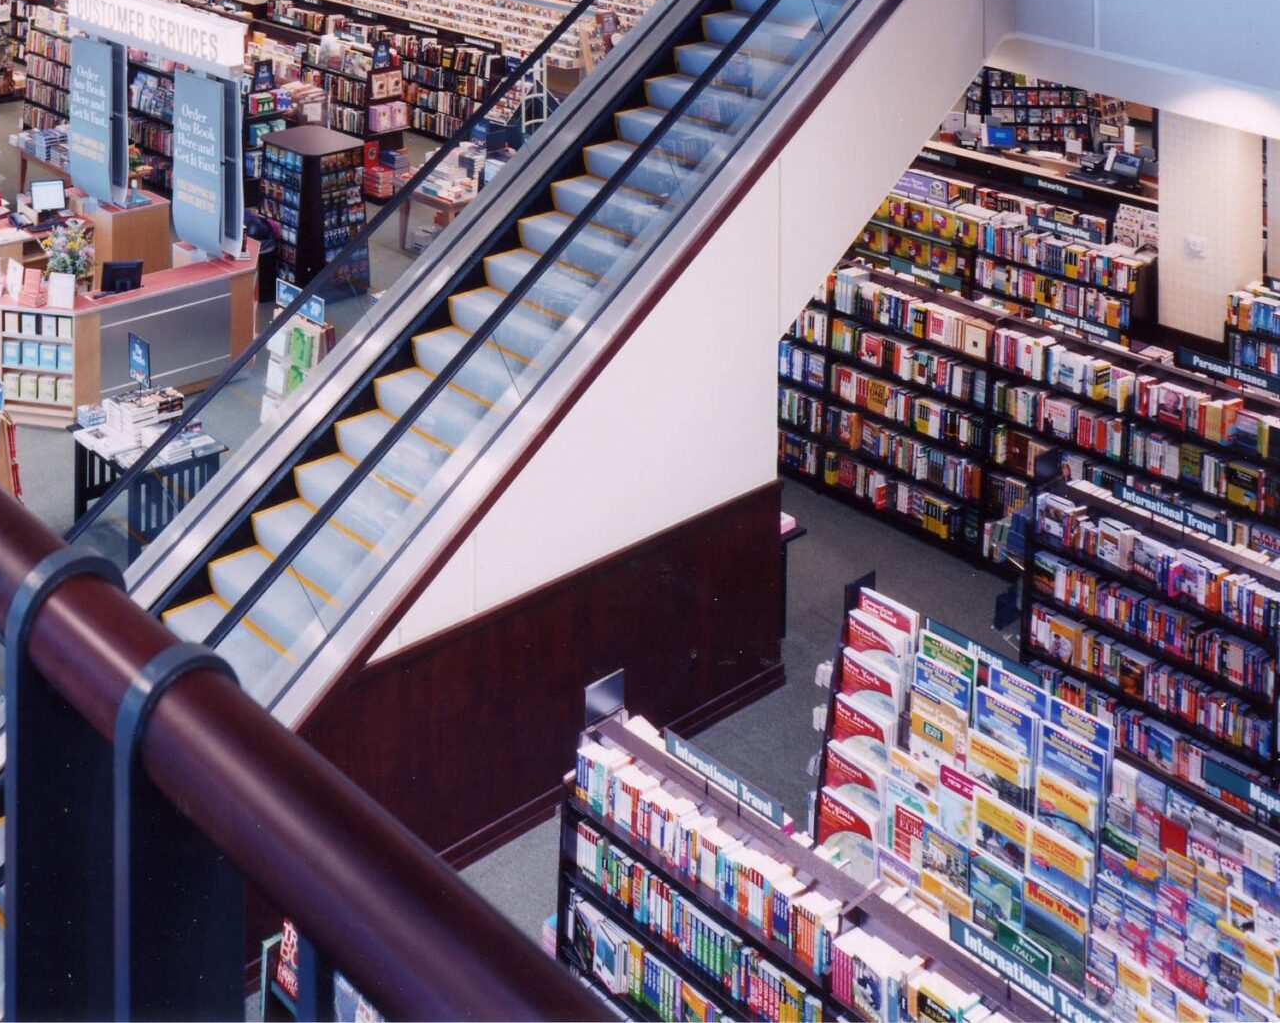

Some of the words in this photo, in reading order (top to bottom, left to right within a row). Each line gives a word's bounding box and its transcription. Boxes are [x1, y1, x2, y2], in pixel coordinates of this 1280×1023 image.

[150, 14, 218, 61] SERVICES
[77, 65, 99, 82] Order
[73, 90, 89, 106] Here
[90, 97, 105, 110] and
[87, 82, 105, 98] Book
[71, 105, 83, 120] Get
[90, 111, 108, 128] Fast.
[181, 104, 208, 123] Order
[178, 118, 192, 135] Any
[193, 124, 216, 142] Book
[178, 133, 197, 149] Here
[198, 142, 215, 157] and
[175, 148, 191, 164] Get
[198, 158, 218, 175] Fast.
[1045, 308, 1077, 327] Personal
[1080, 317, 1108, 337] Finance
[1193, 355, 1231, 376] Personal
[1234, 368, 1267, 388] Finance
[1123, 487, 1183, 523] International
[1187, 512, 1216, 535] Travel
[968, 641, 1003, 669] Atlases
[843, 657, 860, 674] New
[862, 667, 880, 686] York
[836, 702, 852, 717] New
[828, 749, 863, 779] Vermont
[675, 740, 738, 795] International
[740, 782, 772, 818] Travel
[1041, 779, 1063, 797] Suffolk
[821, 794, 856, 823] Virginia
[1026, 881, 1052, 907] New
[1056, 900, 1081, 927] York
[964, 927, 1054, 1008] International
[1011, 943, 1037, 965] ITALY
